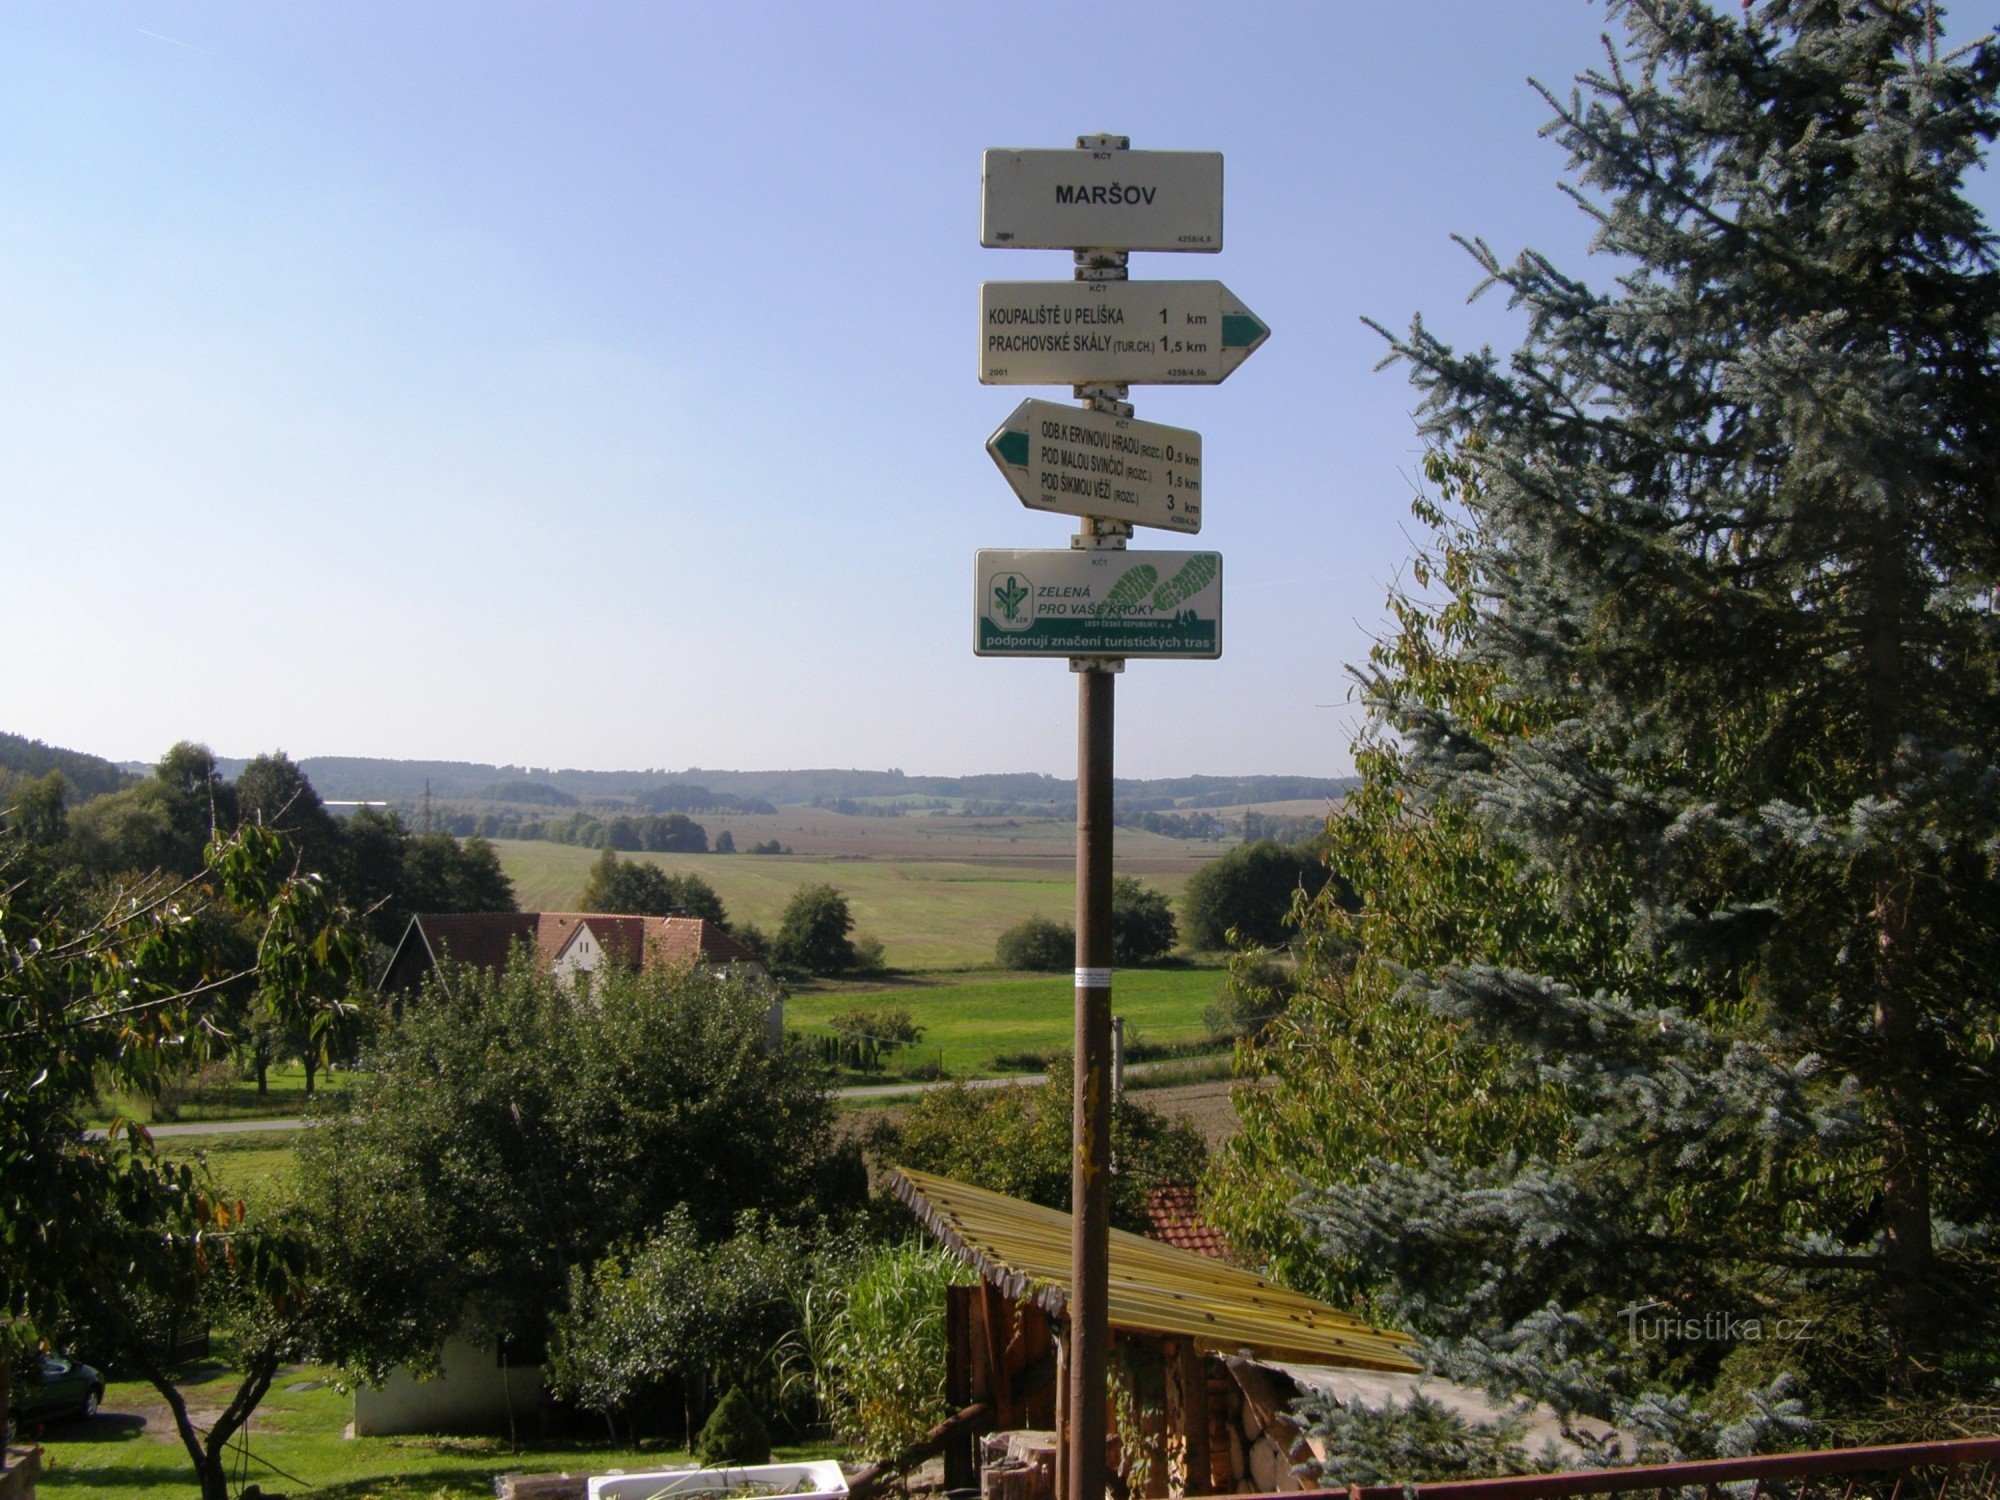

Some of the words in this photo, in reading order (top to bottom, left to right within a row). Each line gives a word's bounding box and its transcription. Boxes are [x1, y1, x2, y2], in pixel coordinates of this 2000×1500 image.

[1055, 182, 1157, 205] MARŠOV
[989, 304, 1060, 325] KOUPALIŠTĚ
[1064, 308, 1072, 324] U
[1075, 304, 1124, 325] PELÍŠKA
[1159, 308, 1168, 324] 1
[1187, 313, 1207, 324] km
[988, 332, 1070, 352] PRACHOVSKÉ
[1073, 332, 1111, 352] SKÁLY
[1114, 341, 1155, 354] (TUR.CH.)
[1159, 336, 1182, 353] 1,5
[1186, 341, 1207, 352] km
[989, 368, 1008, 376] 2001
[1070, 426, 1110, 449] ERVINOVU
[1112, 434, 1140, 455] HRADU
[1166, 445, 1183, 464] 0,5
[1185, 454, 1199, 466] km
[1041, 447, 1059, 465] POD
[1060, 451, 1089, 471] MALOU
[1091, 454, 1124, 477] SVINČICÍ
[1167, 470, 1183, 489] 1,5
[1185, 478, 1199, 491] km
[1041, 472, 1059, 491] POD
[1060, 471, 1092, 497] ŠIKMOU
[1167, 494, 1175, 510] 3
[1185, 502, 1199, 515] km
[1038, 585, 1091, 598] ZELENÁ
[1038, 604, 1067, 614] PRO
[1071, 602, 1105, 615] VAŠE
[1107, 604, 1157, 615] KROKY
[986, 635, 1048, 649] podporují
[1051, 635, 1101, 647] značení
[1105, 636, 1181, 649] turistických
[1185, 638, 1210, 647] tras
